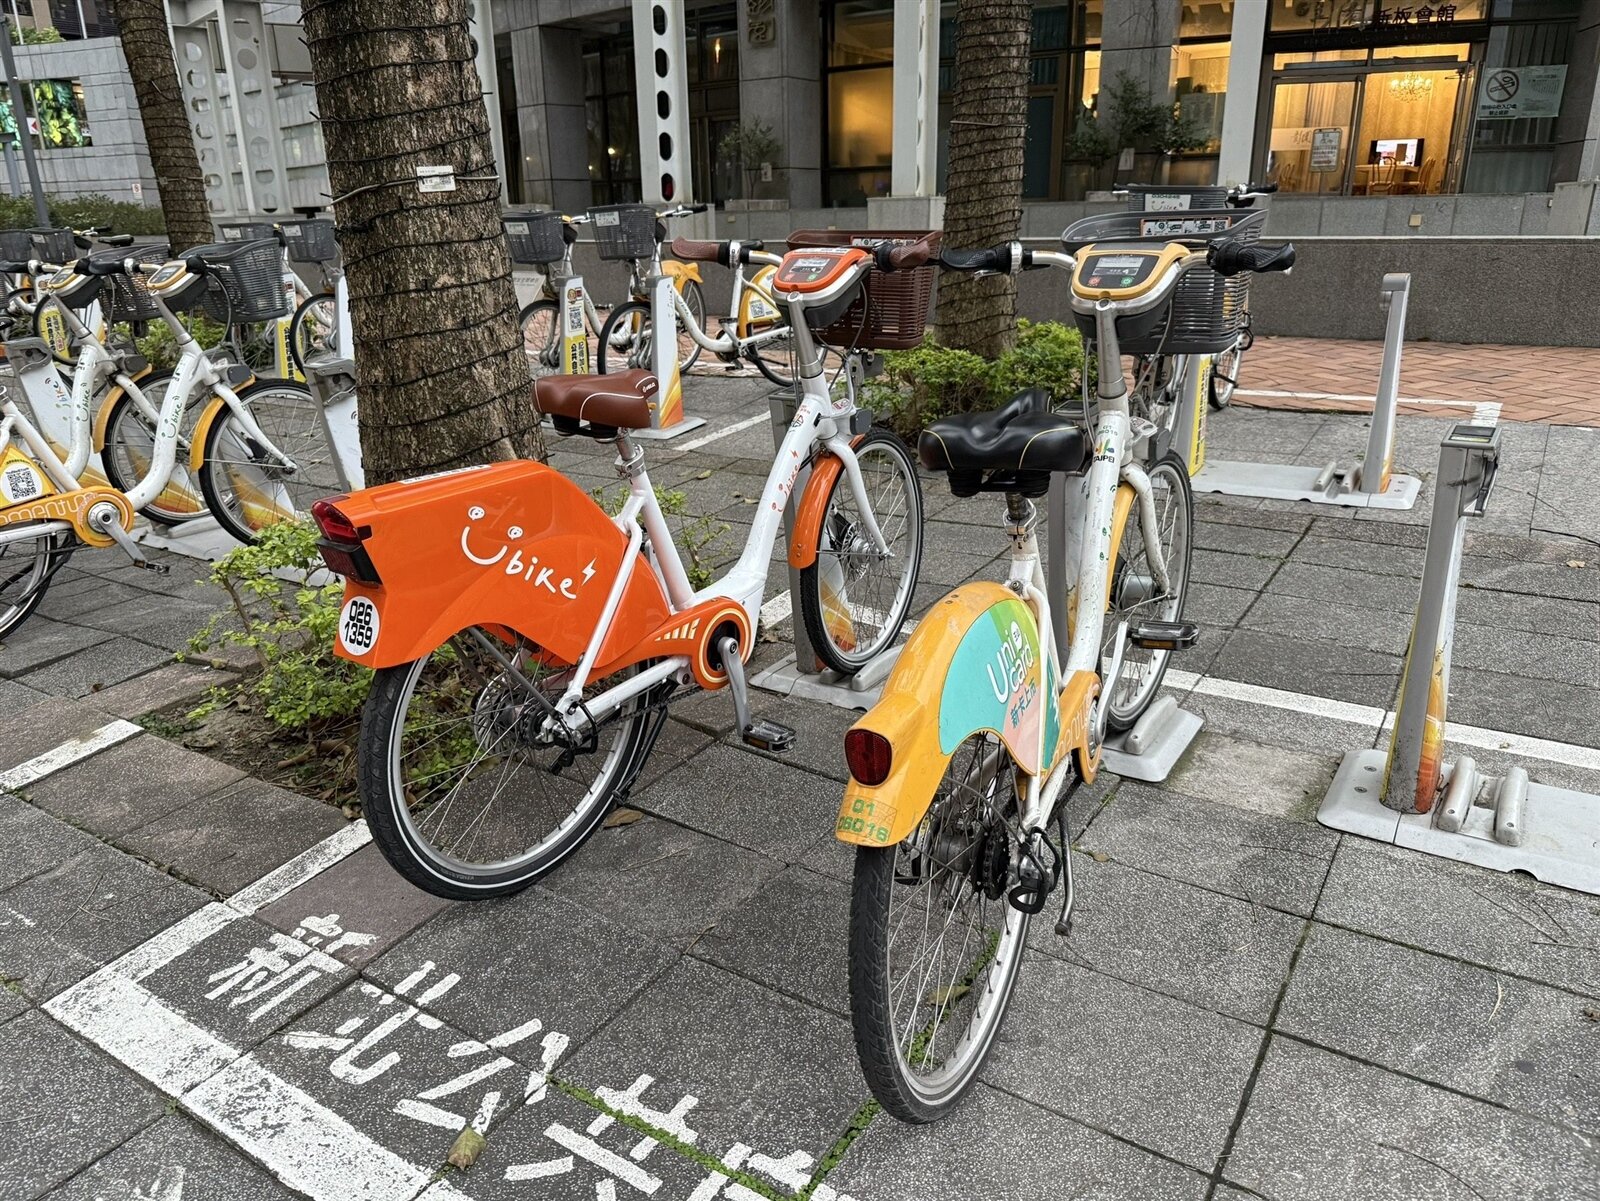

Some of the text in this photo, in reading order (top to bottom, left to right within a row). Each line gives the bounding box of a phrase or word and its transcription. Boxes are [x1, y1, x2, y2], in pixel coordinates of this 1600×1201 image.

[1375, 4, 1457, 27] 新板會館
[349, 600, 373, 626] 026
[344, 621, 373, 648] 1359
[852, 799, 875, 816] 01
